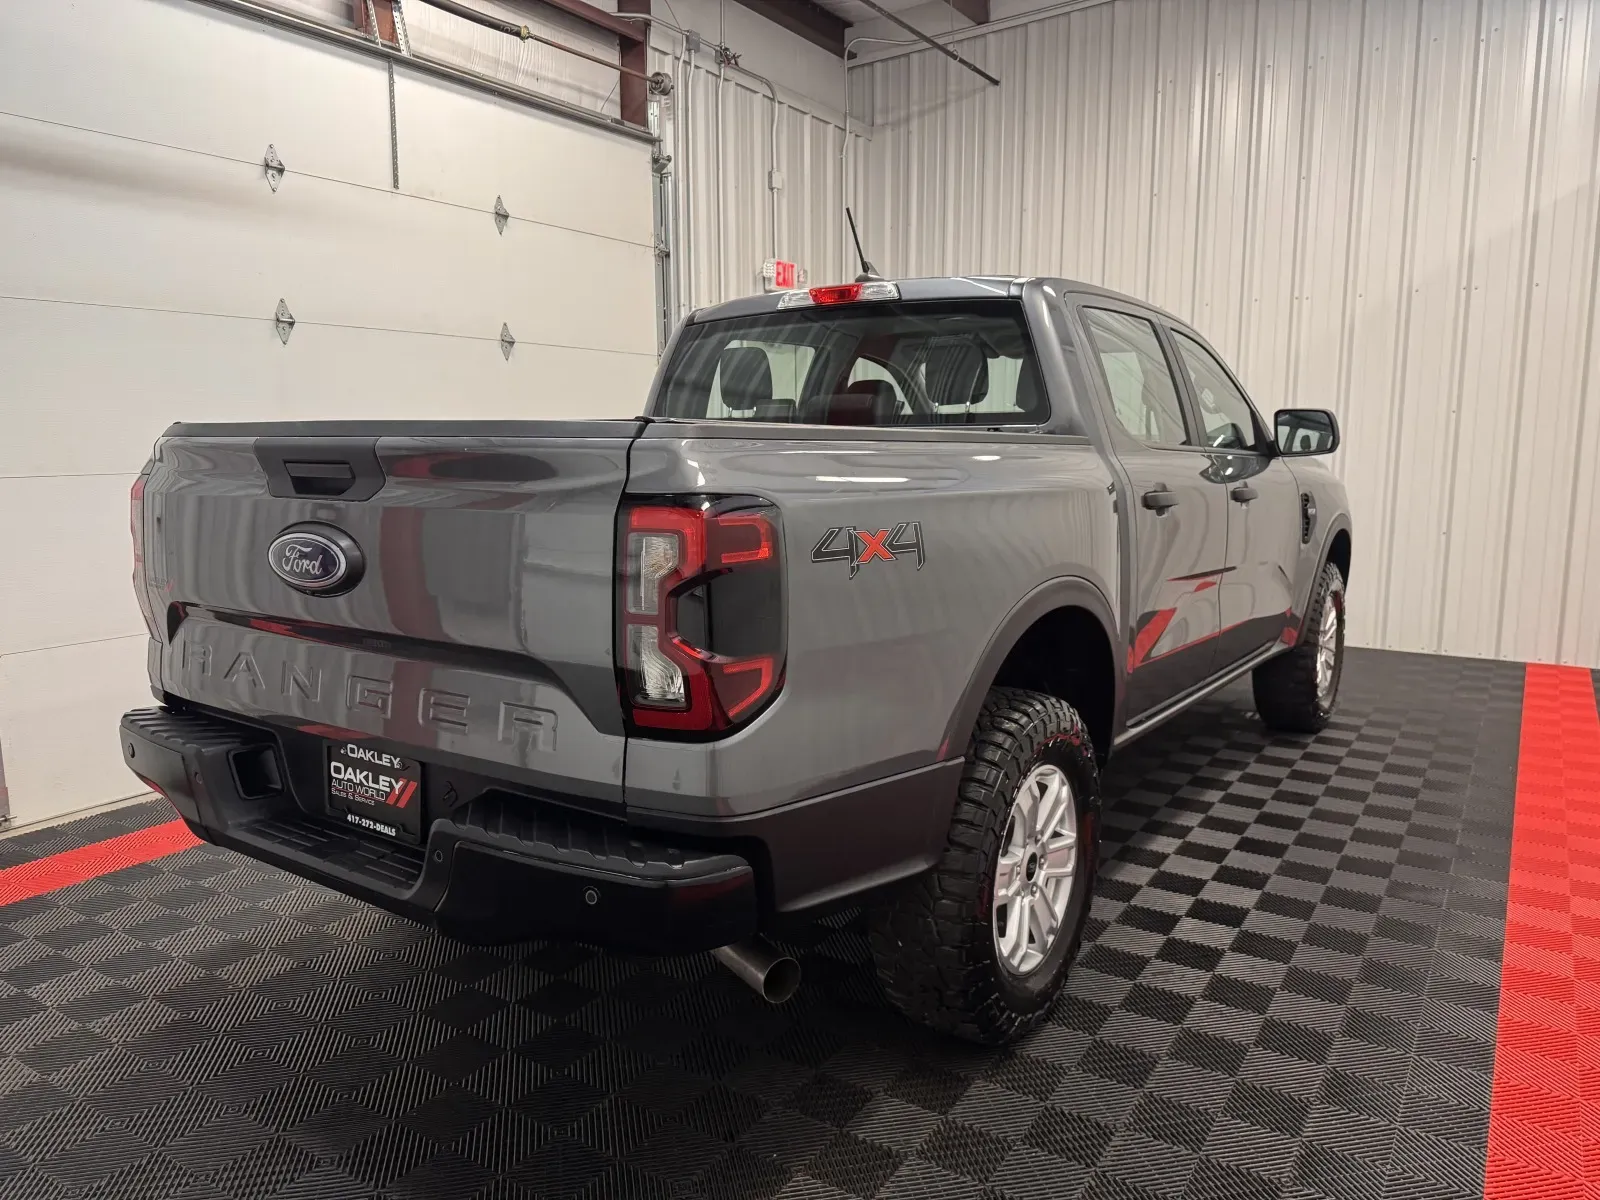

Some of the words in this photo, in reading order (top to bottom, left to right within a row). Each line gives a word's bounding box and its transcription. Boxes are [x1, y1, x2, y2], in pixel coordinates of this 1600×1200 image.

[776, 260, 796, 289] EXIT
[282, 543, 323, 575] Ford
[181, 640, 560, 753] RANGER
[347, 743, 401, 769] OAKLEY
[330, 761, 404, 795] OAKLEY
[331, 778, 354, 792] AUTO
[355, 785, 386, 801] WORLD
[348, 792, 353, 800] &
[346, 813, 396, 836] 417-272-DEALS
